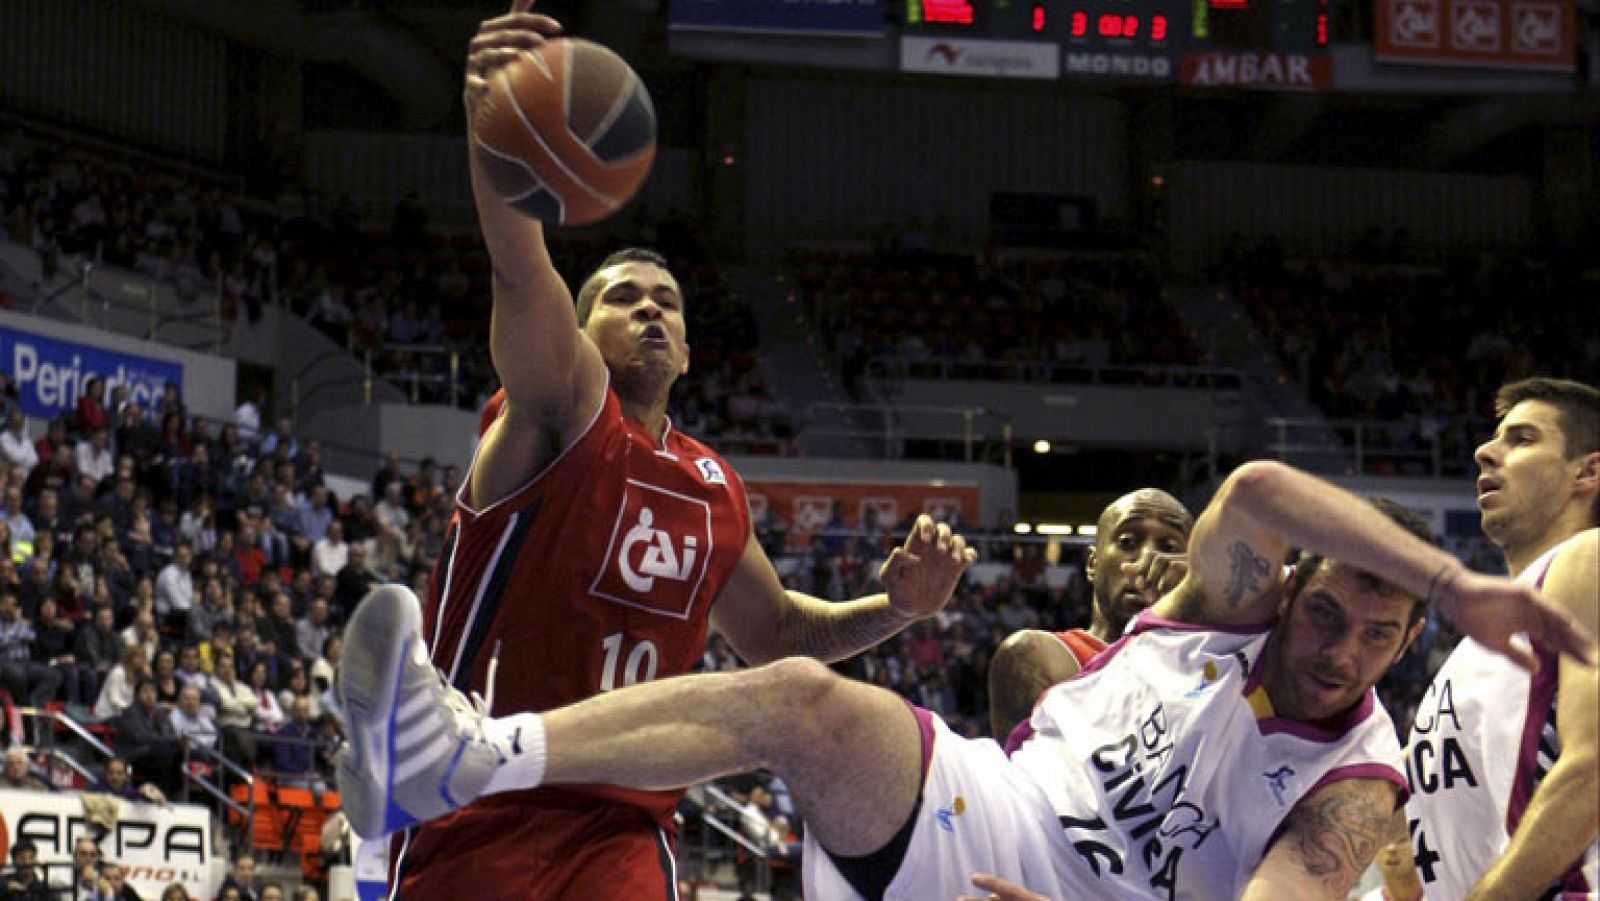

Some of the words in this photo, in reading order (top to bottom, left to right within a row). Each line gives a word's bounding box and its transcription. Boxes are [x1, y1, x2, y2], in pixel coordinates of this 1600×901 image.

[1066, 53, 1170, 76] MONDO
[1191, 54, 1313, 86] AMBAR
[14, 343, 165, 412] Peridc
[601, 633, 658, 692] 10
[1140, 703, 1221, 851] BNCA
